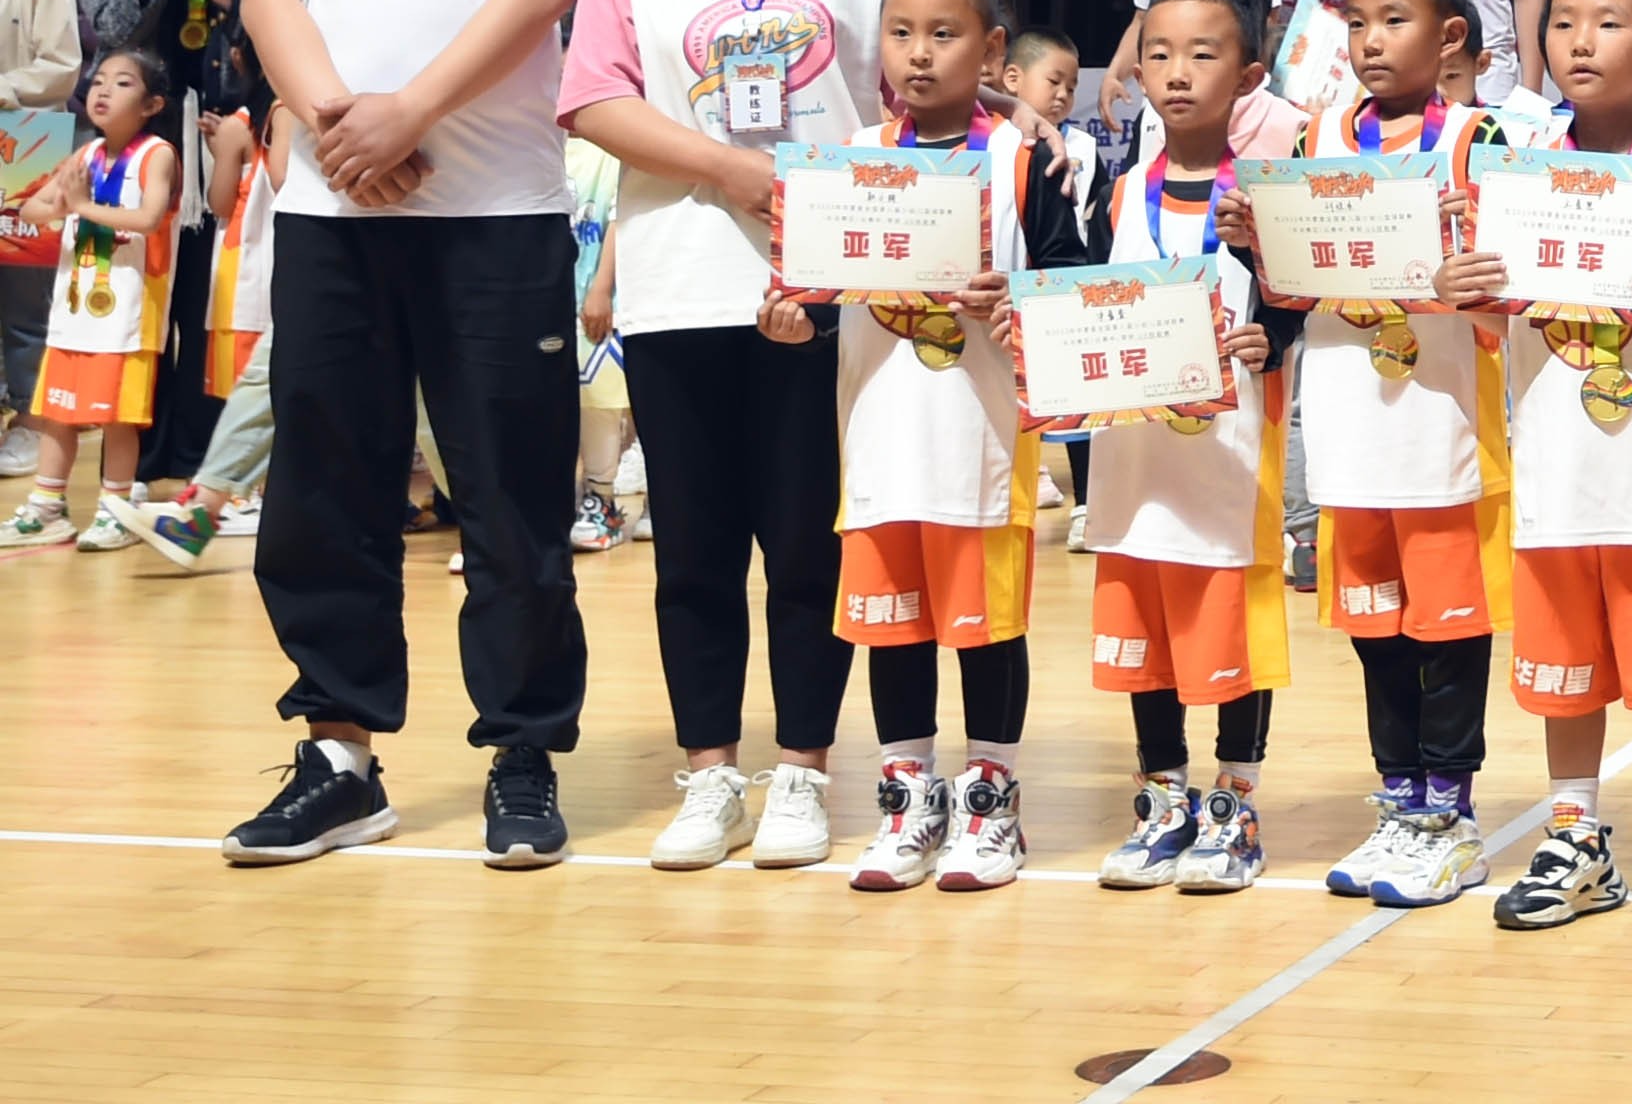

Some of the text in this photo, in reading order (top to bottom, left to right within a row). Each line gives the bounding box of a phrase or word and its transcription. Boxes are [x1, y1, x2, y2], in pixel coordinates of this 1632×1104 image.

[843, 230, 911, 261] 亚军
[1310, 240, 1376, 269] 亚军
[1536, 238, 1605, 272] 亚军
[1081, 347, 1149, 382] 亚军
[846, 590, 921, 624] 华蒙星
[1092, 634, 1148, 669] 蒙星
[1514, 656, 1593, 696] 华蒙星
